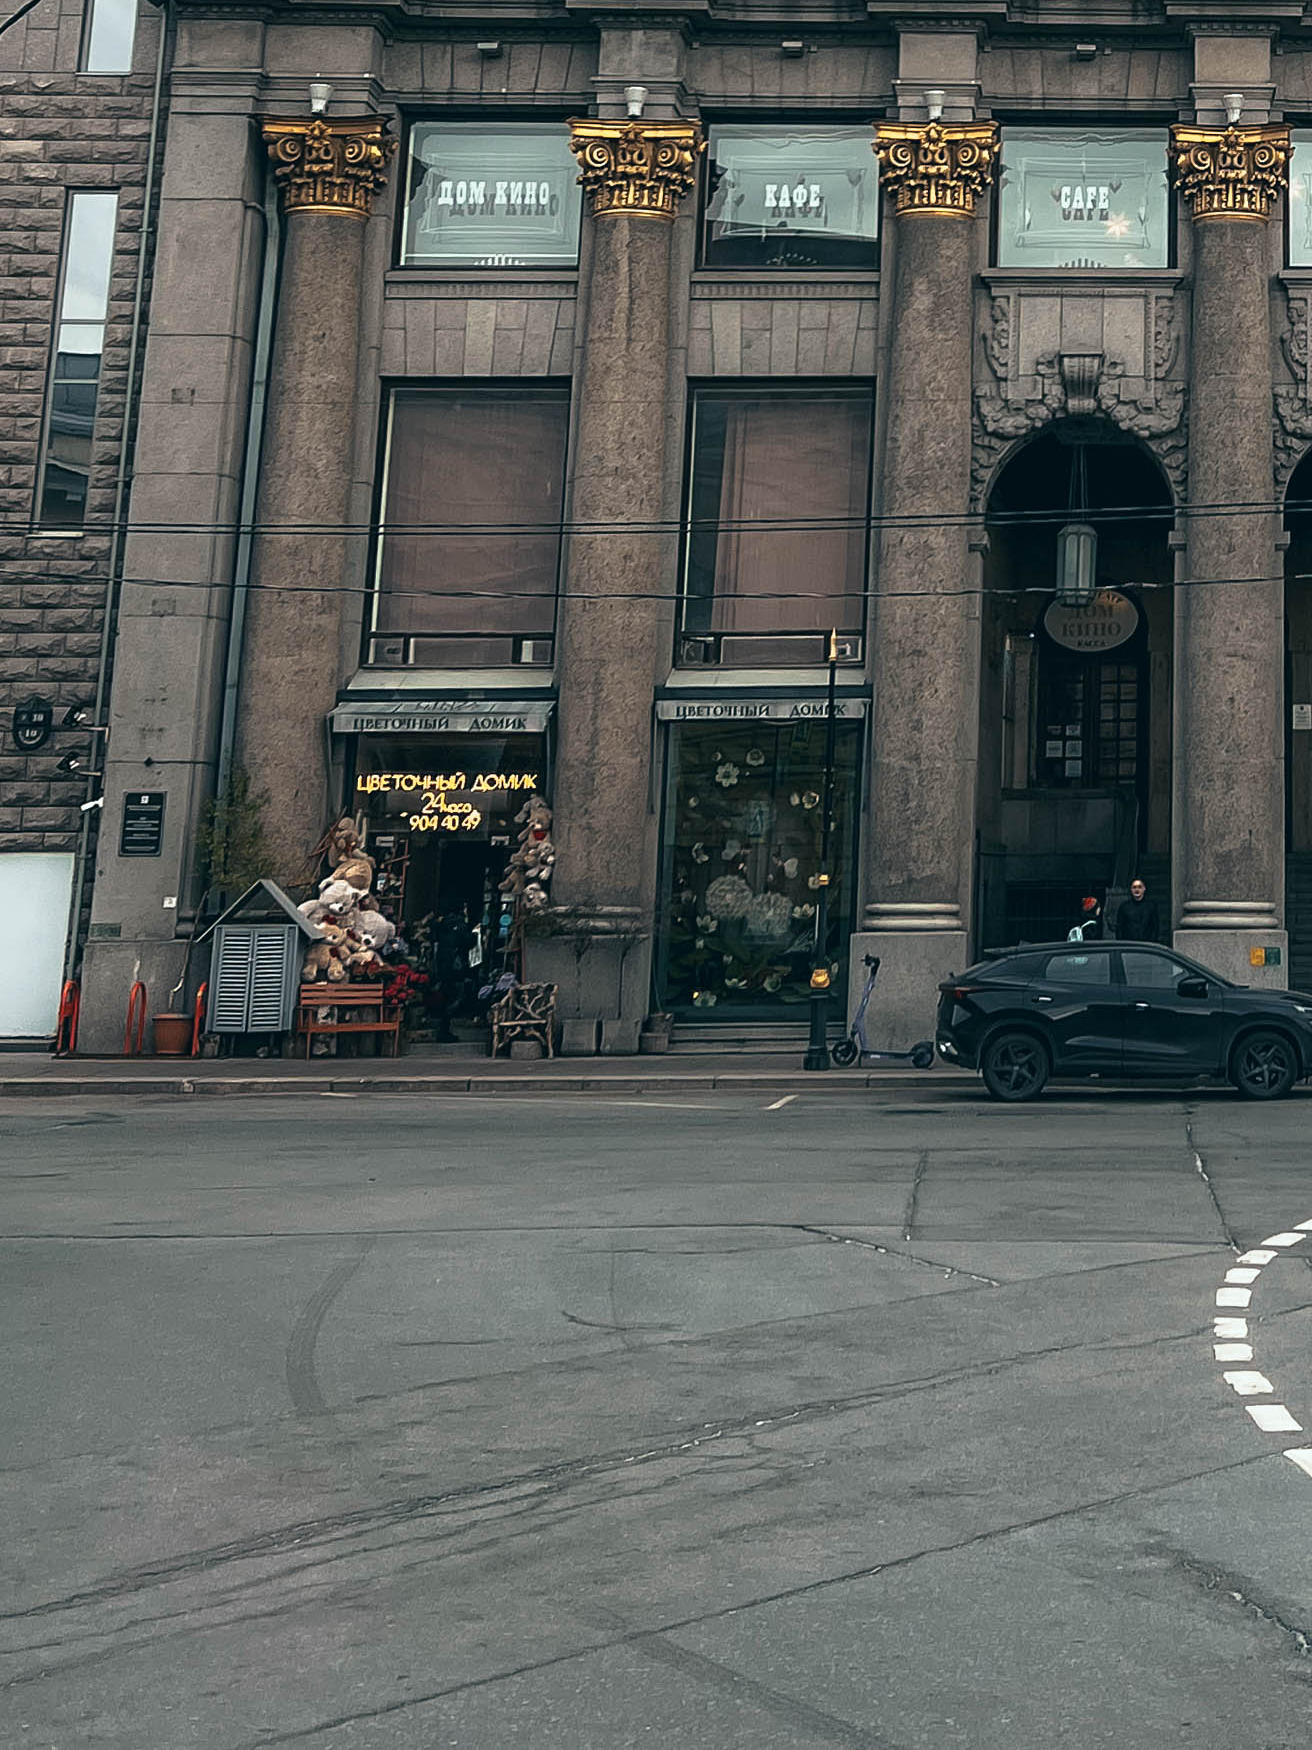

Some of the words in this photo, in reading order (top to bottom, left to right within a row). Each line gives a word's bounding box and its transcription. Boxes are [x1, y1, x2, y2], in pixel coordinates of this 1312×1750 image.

[438, 181, 486, 205] ДОМ
[495, 181, 550, 205] КИНО
[764, 184, 820, 207] КАФЕ
[1061, 186, 1109, 209] CAFE
[1060, 622, 1122, 637] КИНО
[675, 703, 771, 719] ЦВЕТОЧНЫЙ
[353, 716, 450, 732] ЦВЕТОЧНЫЙ
[469, 717, 527, 732] ДОМИК
[356, 772, 466, 794] ЦВЕТОЧНЫЙ
[470, 773, 538, 793] ДОМИК
[409, 815, 439, 832] 904
[440, 815, 460, 831] 40
[461, 811, 482, 831] 49
